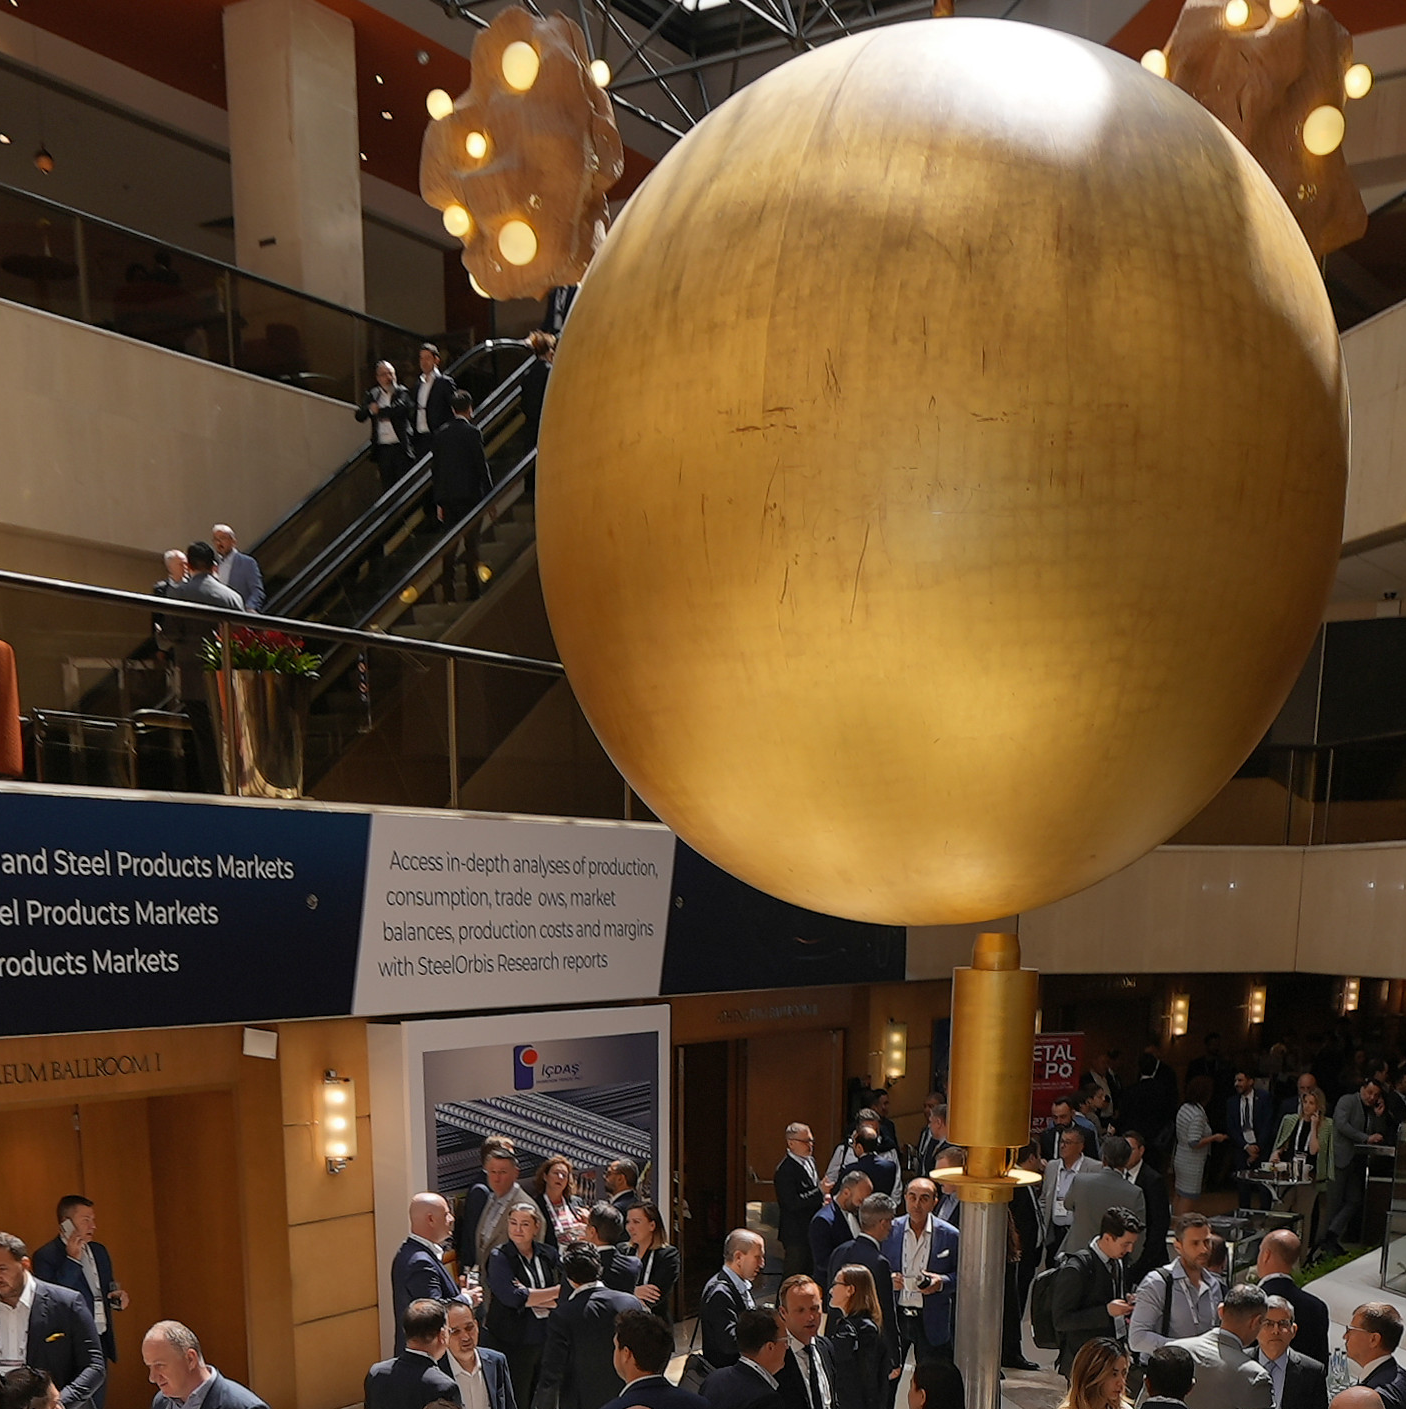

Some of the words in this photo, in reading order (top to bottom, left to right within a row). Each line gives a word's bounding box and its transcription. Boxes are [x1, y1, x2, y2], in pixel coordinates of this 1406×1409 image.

[1, 847, 48, 875] and
[53, 849, 111, 876] Steel
[116, 851, 213, 878] Products
[217, 854, 294, 879] Markets
[389, 850, 444, 872] Access
[446, 851, 510, 877] in-depth
[513, 854, 571, 879] analyses
[573, 856, 586, 875] of
[588, 857, 658, 879] production,
[26, 898, 130, 926] Products
[135, 899, 219, 925] Markets
[386, 886, 493, 911] consumption,
[495, 887, 532, 907] trade
[570, 888, 616, 907] market
[382, 920, 455, 944] balances,
[458, 919, 537, 945] production
[539, 921, 574, 939] costs
[576, 919, 601, 938] and
[603, 919, 654, 941] margins
[92, 947, 180, 974] Markets
[378, 956, 415, 977] with
[417, 953, 495, 976] SteelOrbis
[497, 951, 560, 973] Research
[562, 952, 609, 973] reports
[51, 1054, 150, 1081] BALLROOM
[155, 1052, 162, 1072] I
[1033, 1044, 1077, 1062] ETAL
